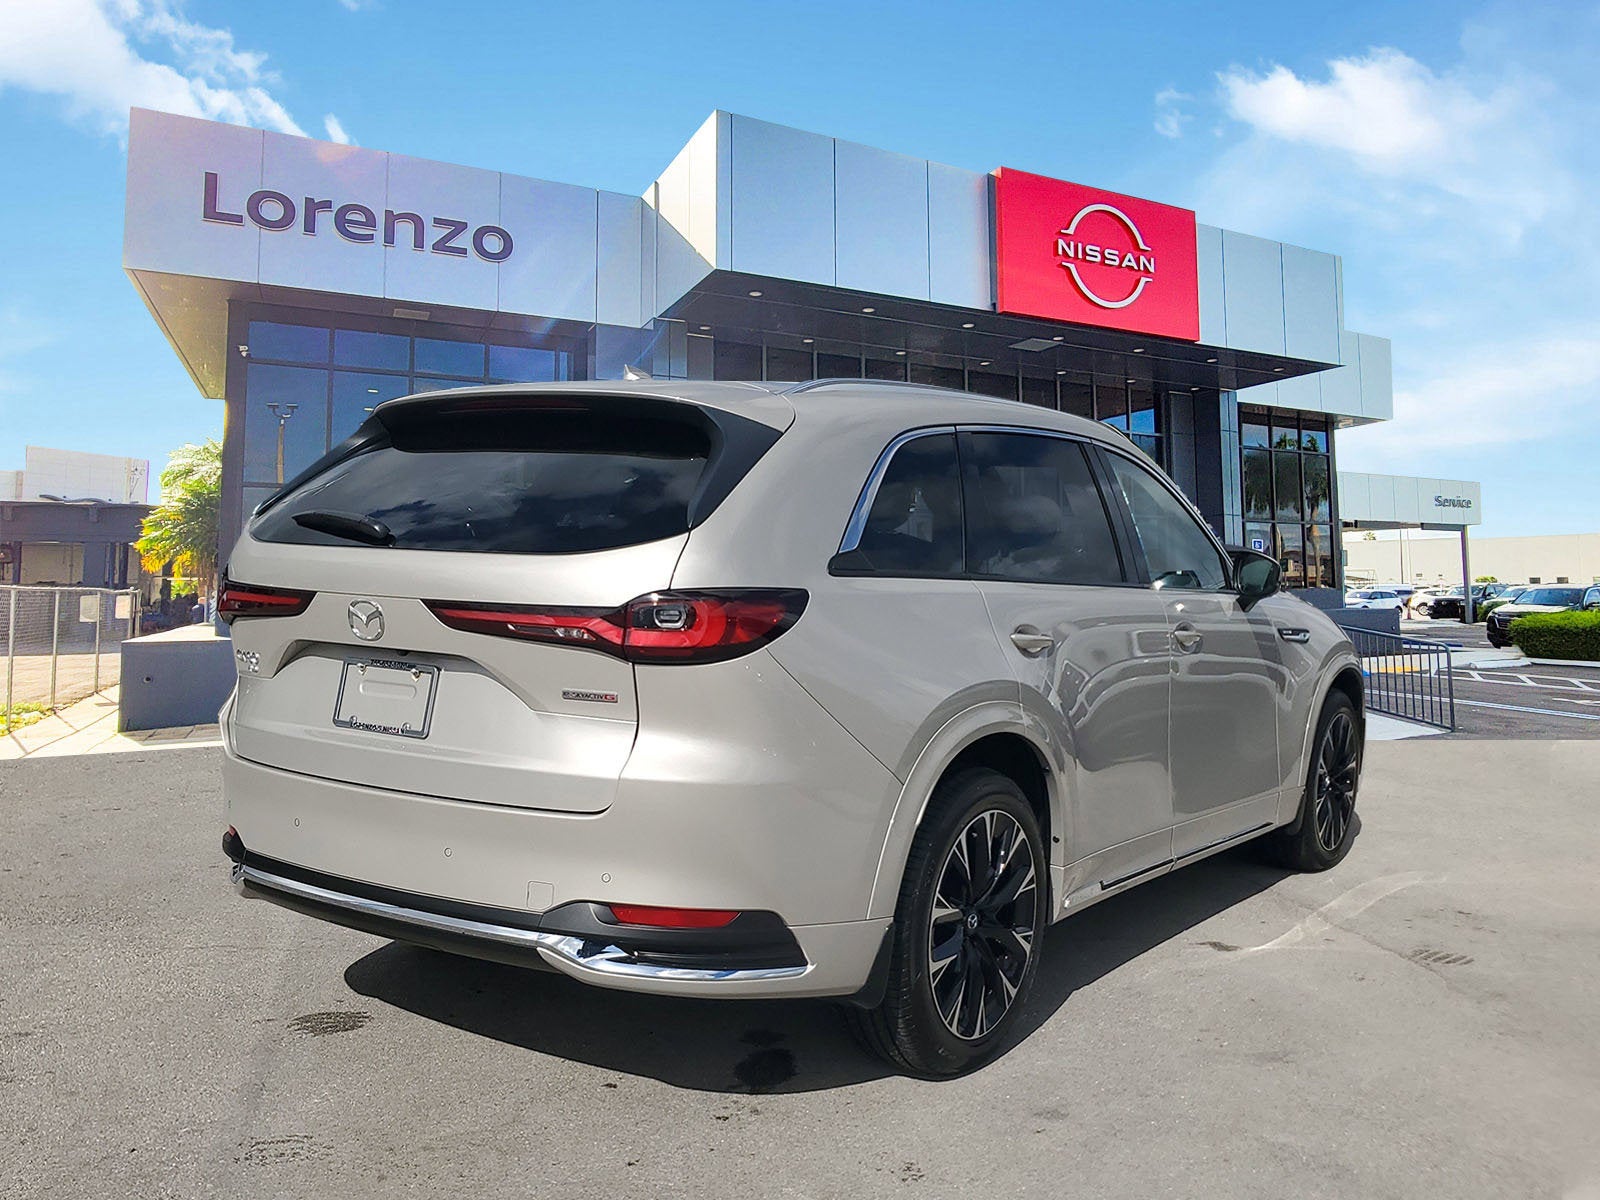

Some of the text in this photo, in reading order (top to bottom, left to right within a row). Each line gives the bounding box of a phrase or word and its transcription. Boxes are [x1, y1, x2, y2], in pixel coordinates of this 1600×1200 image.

[202, 171, 515, 262] Lorenzo
[1057, 238, 1155, 273] NISSAN
[1434, 495, 1472, 508] Service
